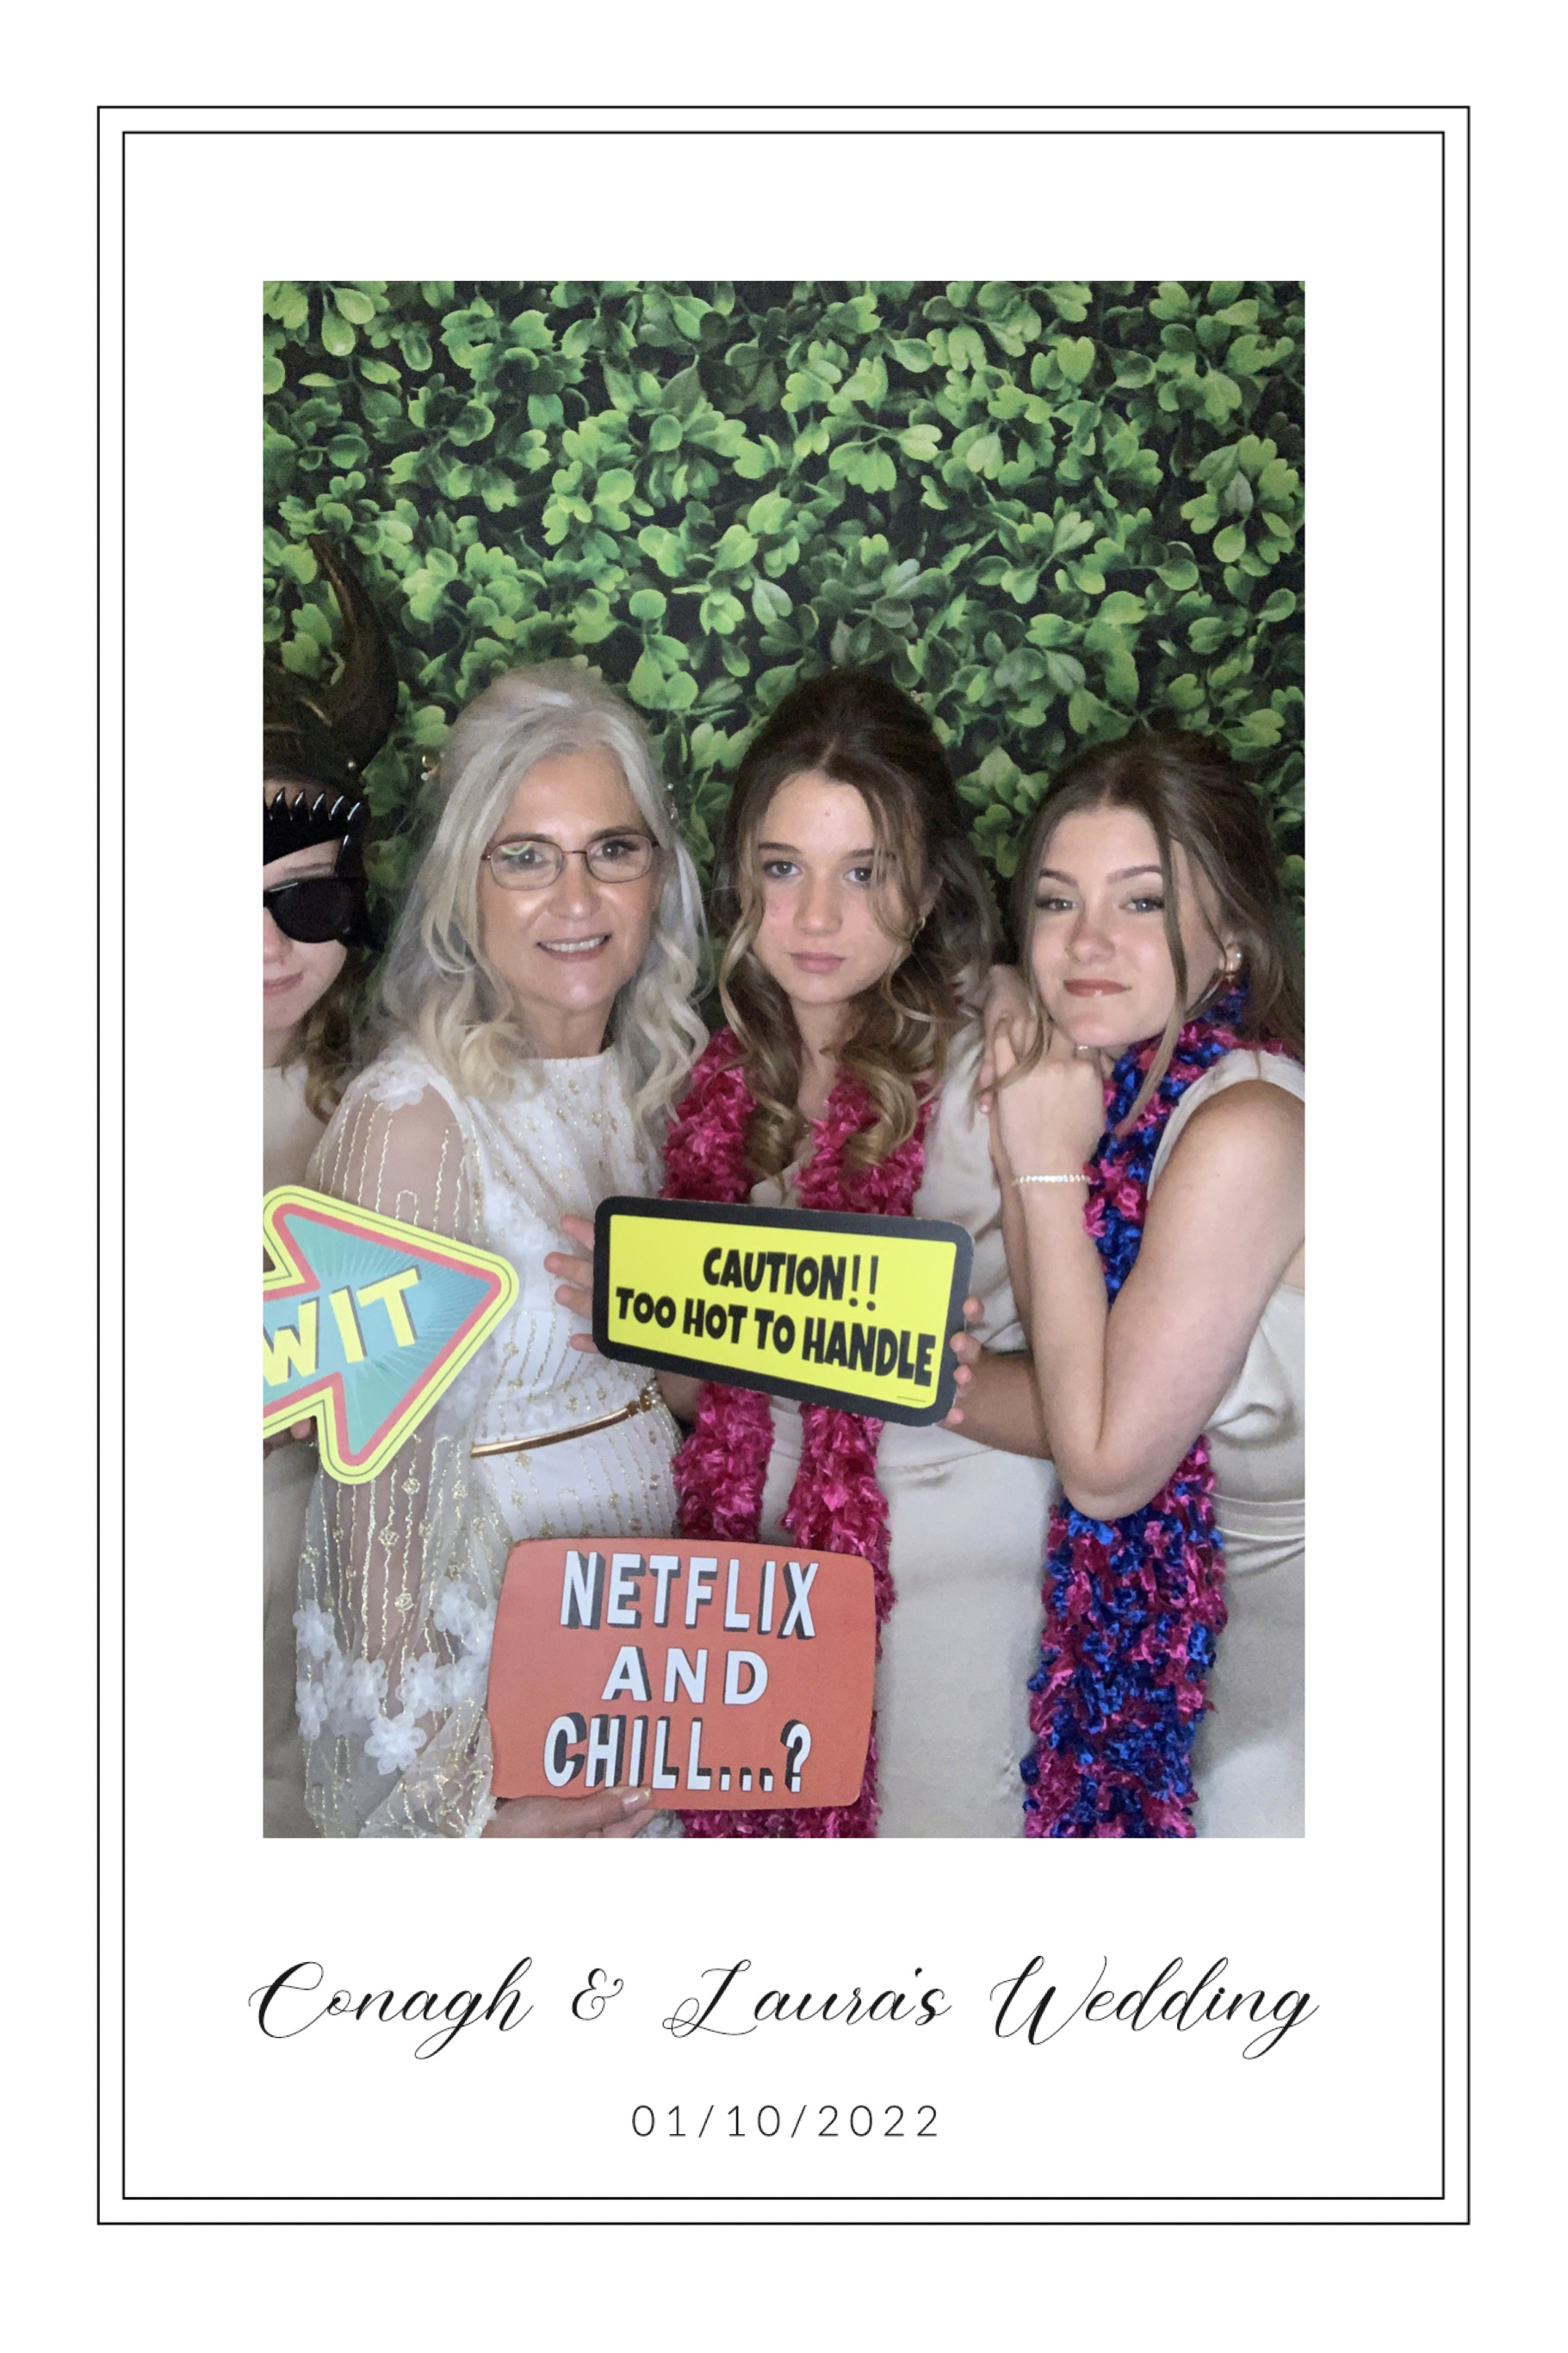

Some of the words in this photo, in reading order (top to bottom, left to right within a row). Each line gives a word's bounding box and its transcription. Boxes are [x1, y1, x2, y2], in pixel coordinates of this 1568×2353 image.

[702, 1246, 879, 1312] CAUTION!!
[616, 1286, 677, 1329] TOO
[682, 1297, 748, 1344] HOT
[754, 1307, 796, 1355] TO
[801, 1316, 937, 1388] HANDLE
[560, 1549, 820, 1640] NETFLIX
[600, 1645, 769, 1705] AND
[543, 1710, 813, 1793] CHILL...?
